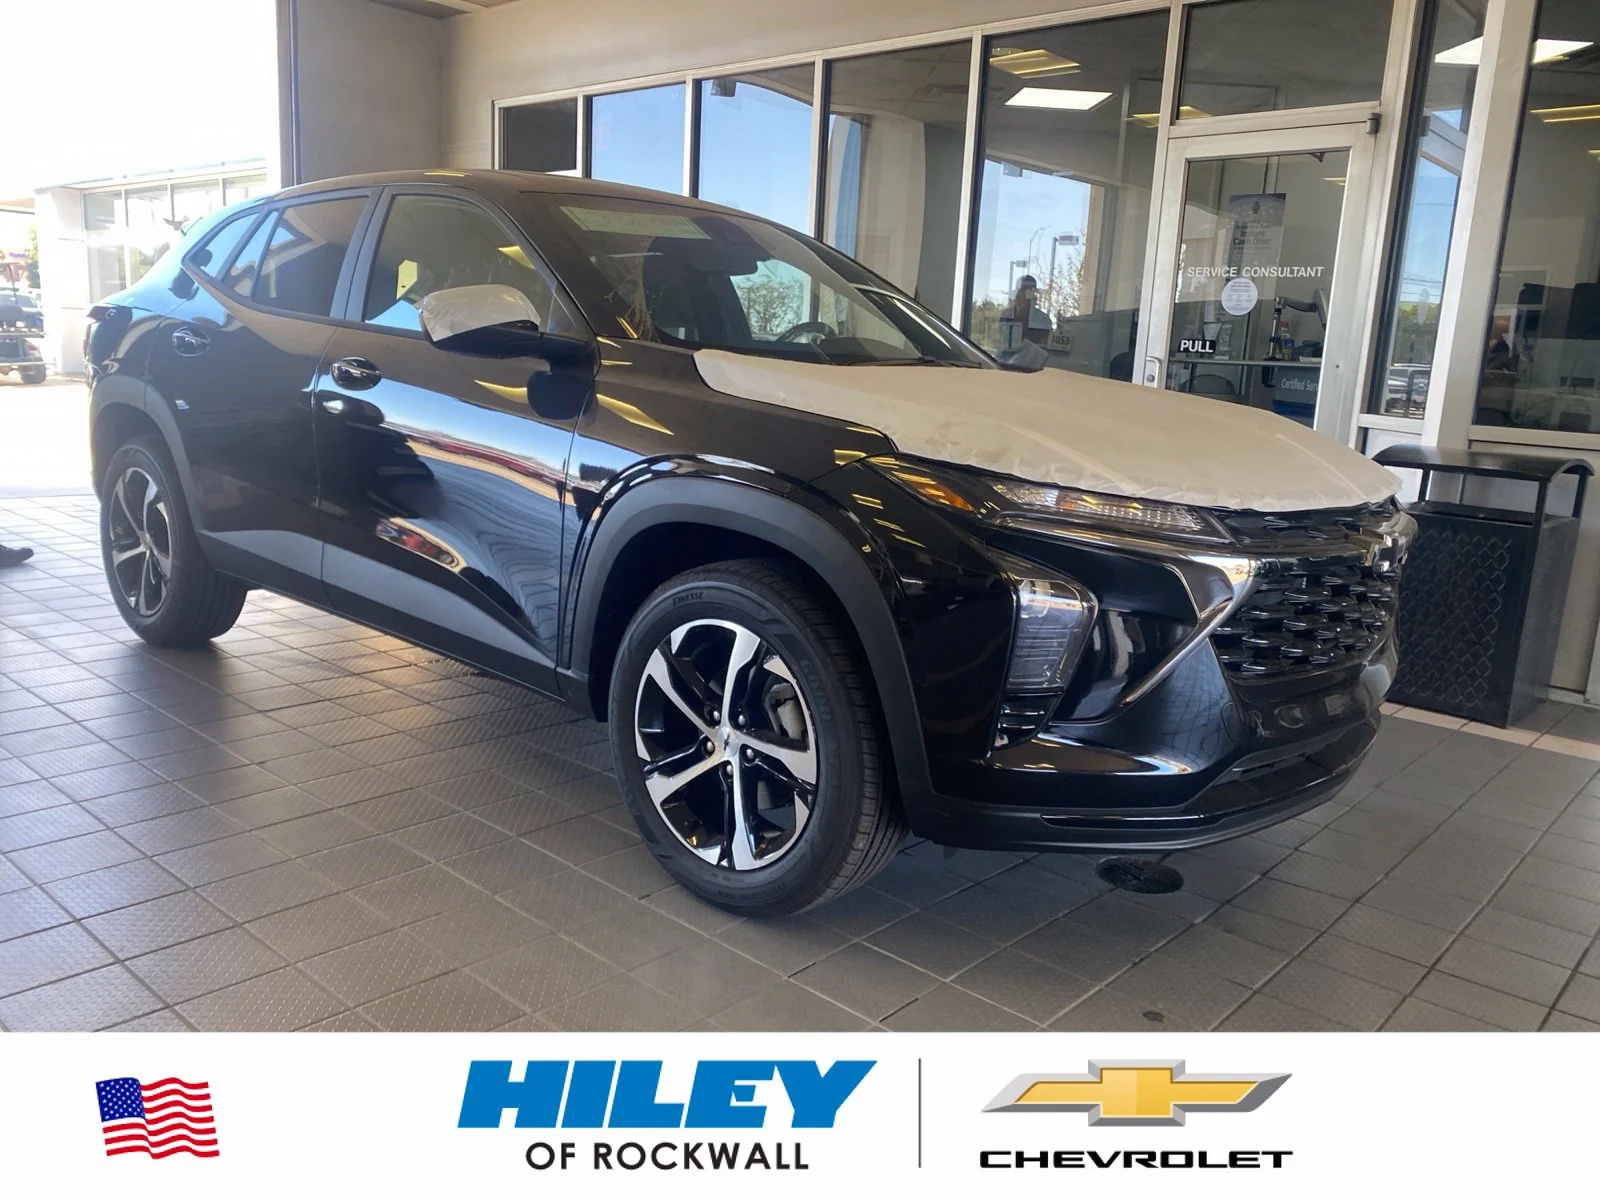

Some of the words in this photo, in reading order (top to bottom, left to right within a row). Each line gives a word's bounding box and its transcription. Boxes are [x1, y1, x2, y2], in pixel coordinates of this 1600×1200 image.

[1187, 266, 1237, 277] SERVICE
[1242, 266, 1324, 277] CONSULTANT
[1180, 339, 1214, 353] PULL
[1281, 378, 1306, 391] Certified
